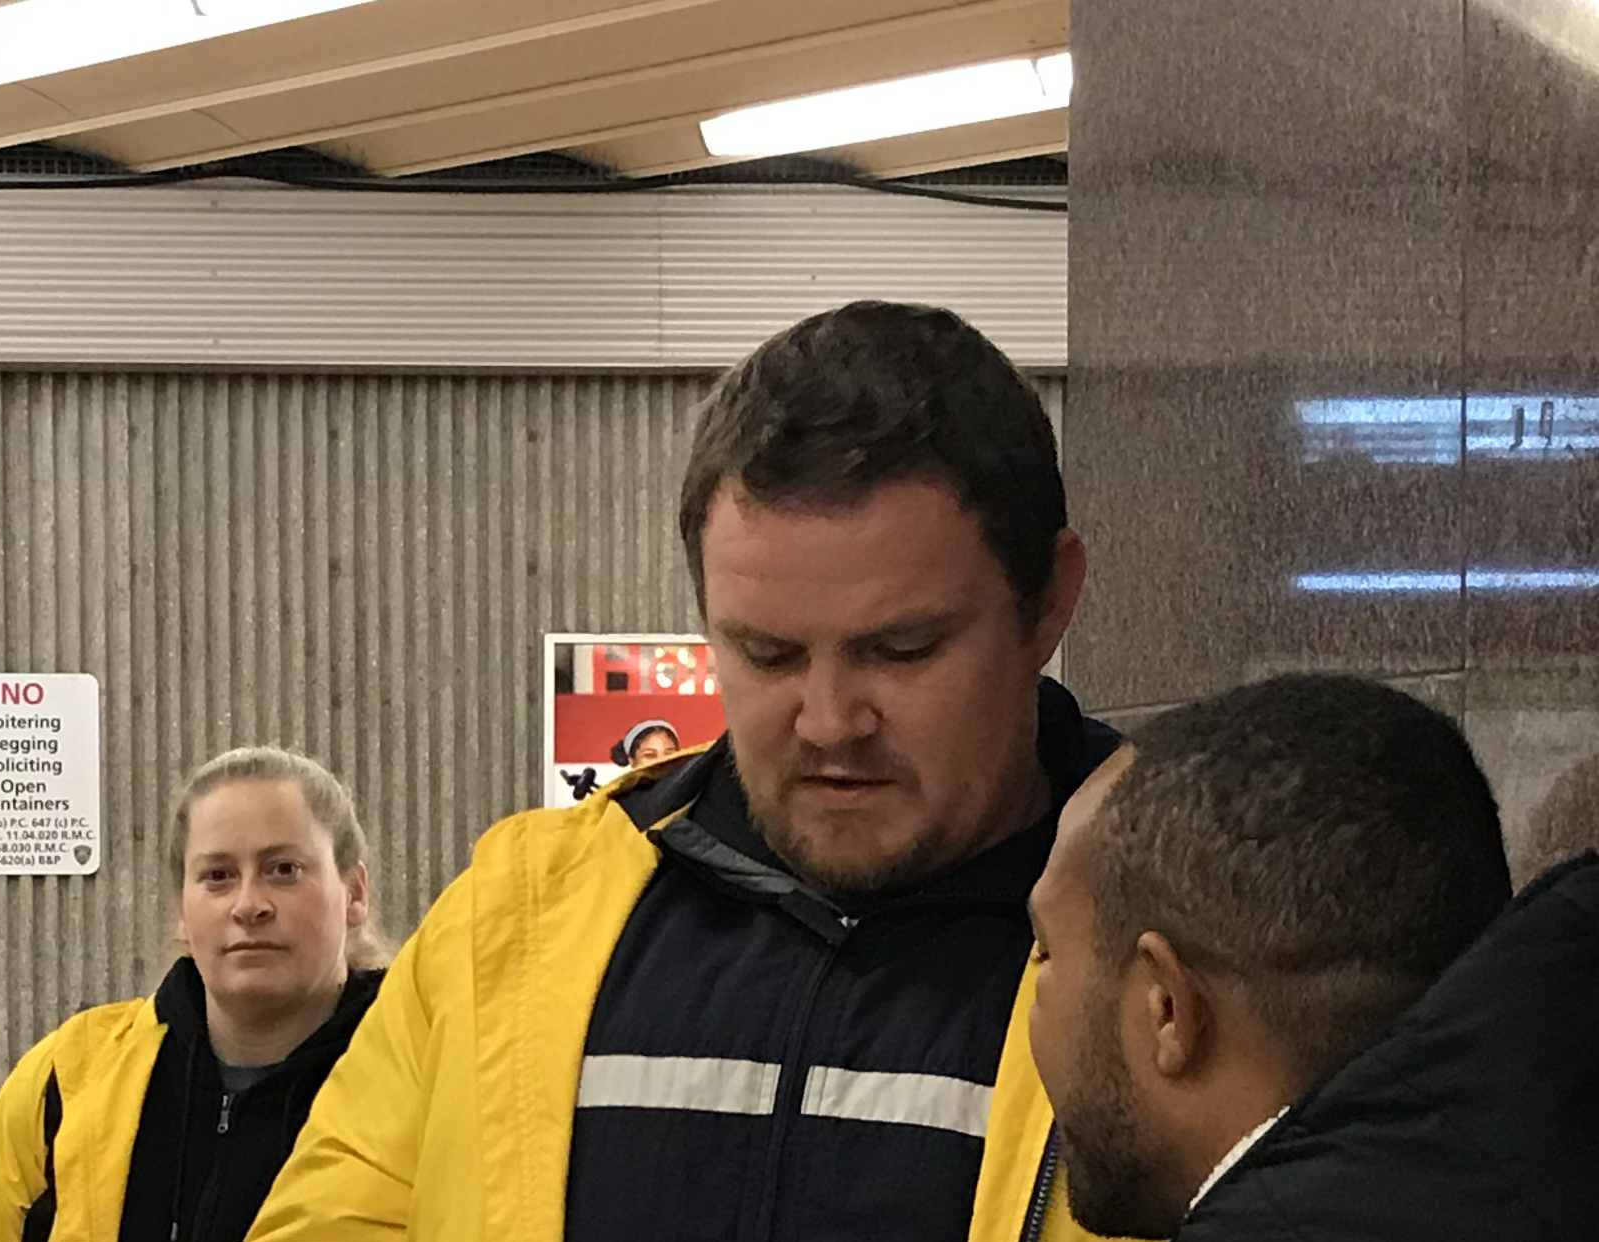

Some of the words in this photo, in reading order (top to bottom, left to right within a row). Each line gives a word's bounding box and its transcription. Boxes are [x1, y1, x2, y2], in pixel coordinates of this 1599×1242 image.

[1, 682, 45, 705] NO
[0, 778, 47, 797] Open
[31, 817, 52, 828] 647
[54, 817, 68, 830] (c)
